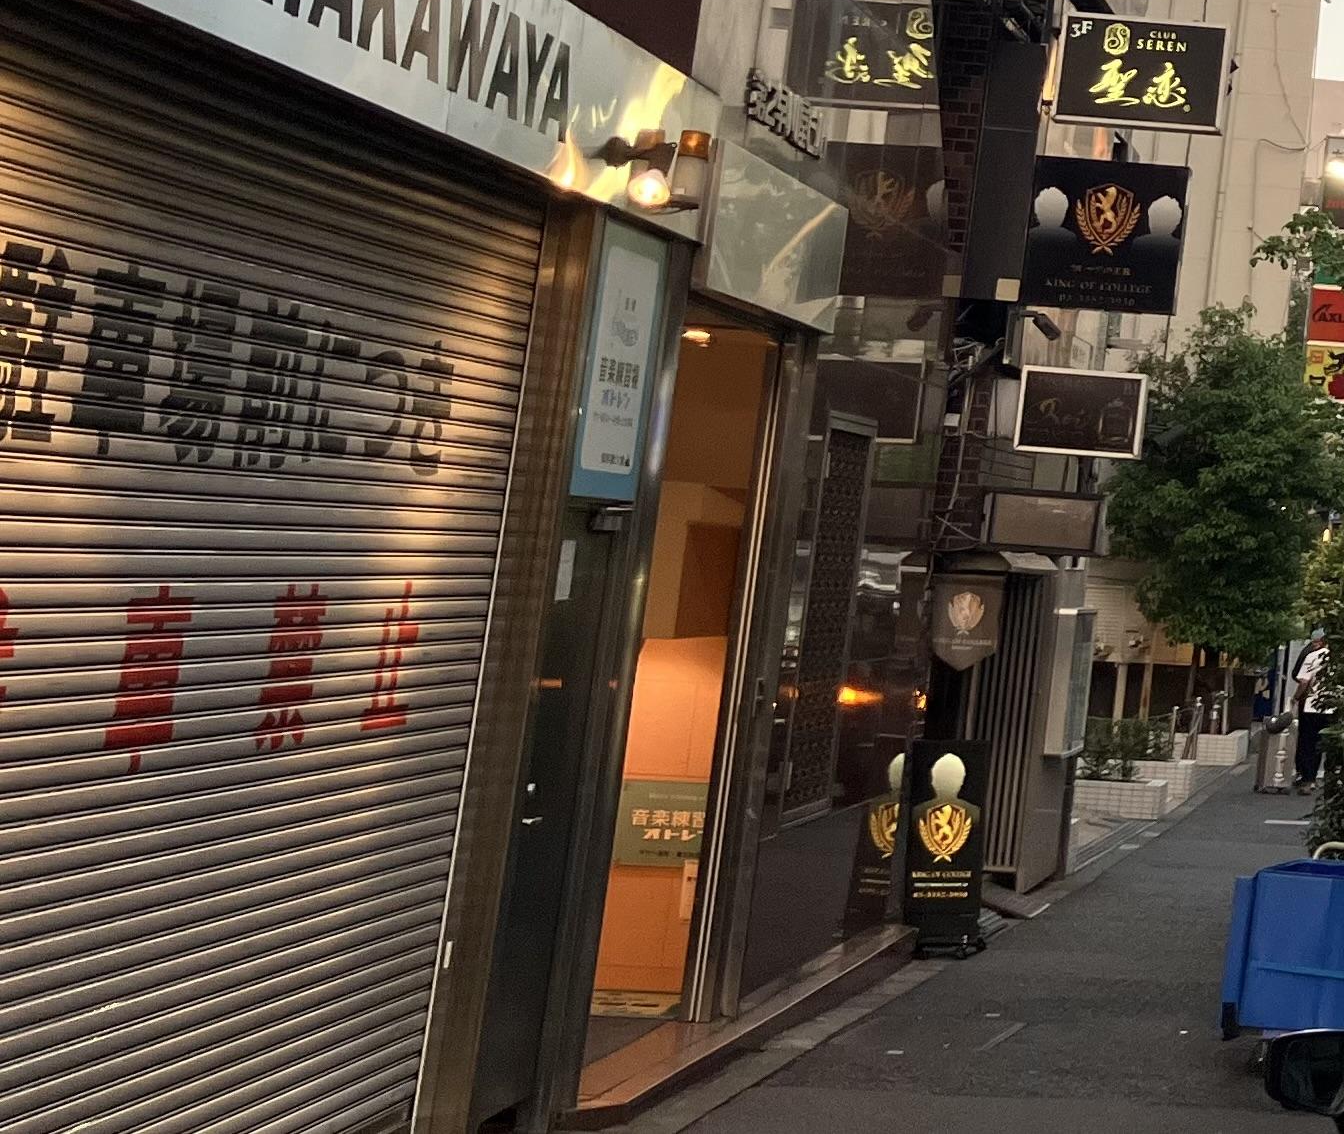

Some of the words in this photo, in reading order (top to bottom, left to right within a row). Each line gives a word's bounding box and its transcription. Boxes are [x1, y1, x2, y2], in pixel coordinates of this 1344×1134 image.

[1070, 20, 1093, 38] 3F
[1150, 30, 1177, 40] CLUB
[1136, 38, 1187, 52] SEREN
[642, 828, 704, 842] オトレ
